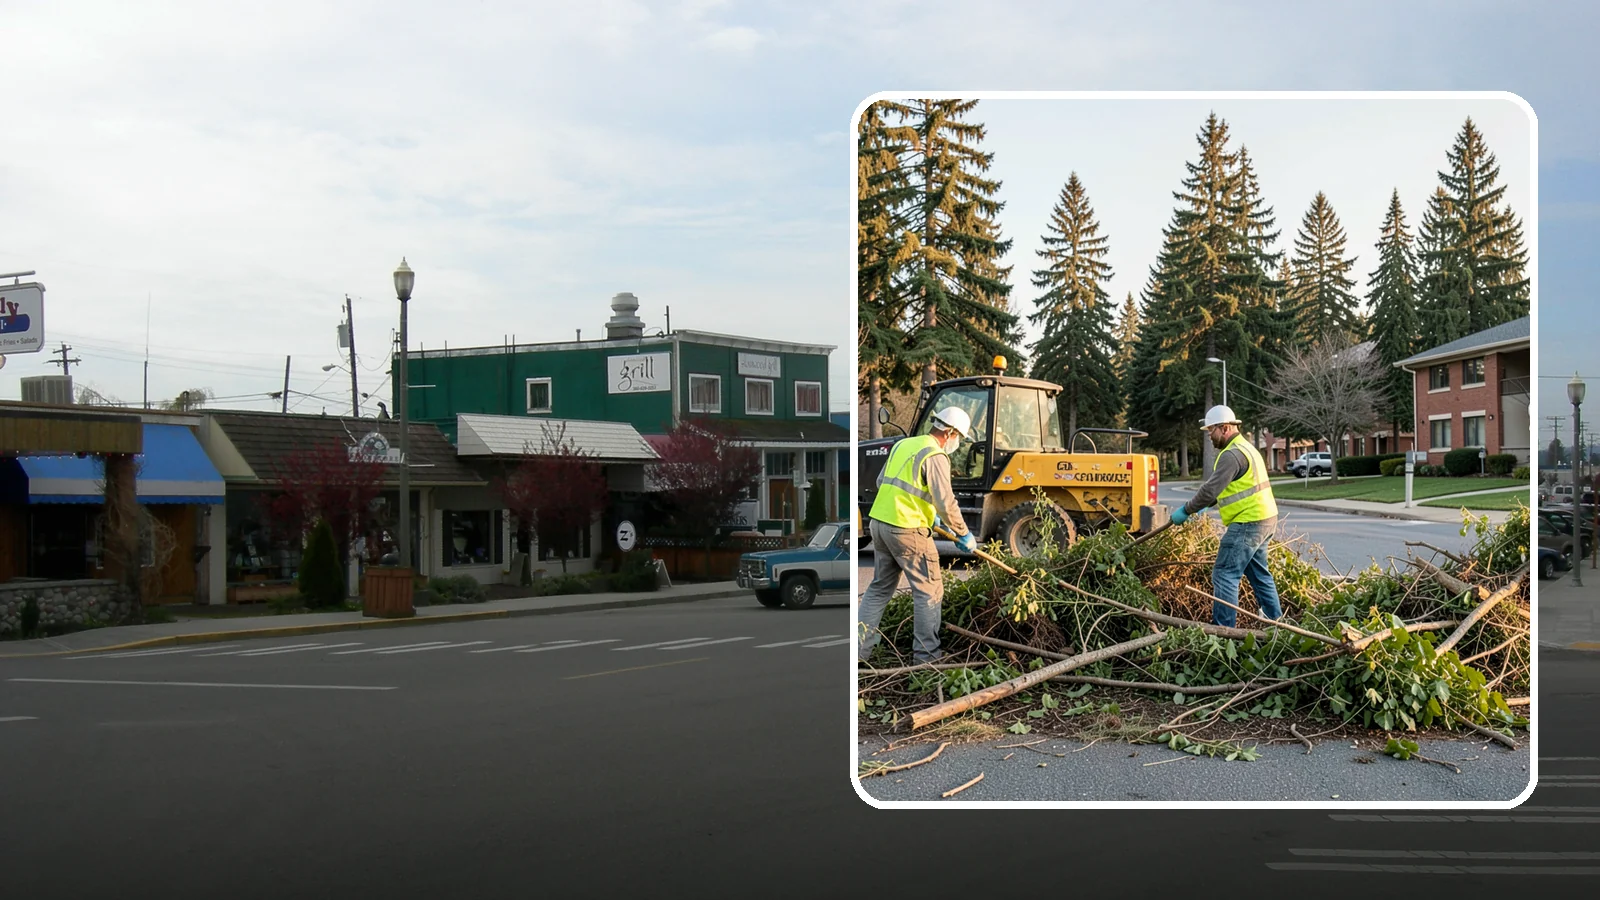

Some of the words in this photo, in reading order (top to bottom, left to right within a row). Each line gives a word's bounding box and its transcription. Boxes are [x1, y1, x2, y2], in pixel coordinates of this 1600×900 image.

[3, 338, 16, 346] Fries
[20, 337, 38, 345] Salads
[617, 355, 655, 392] grill
